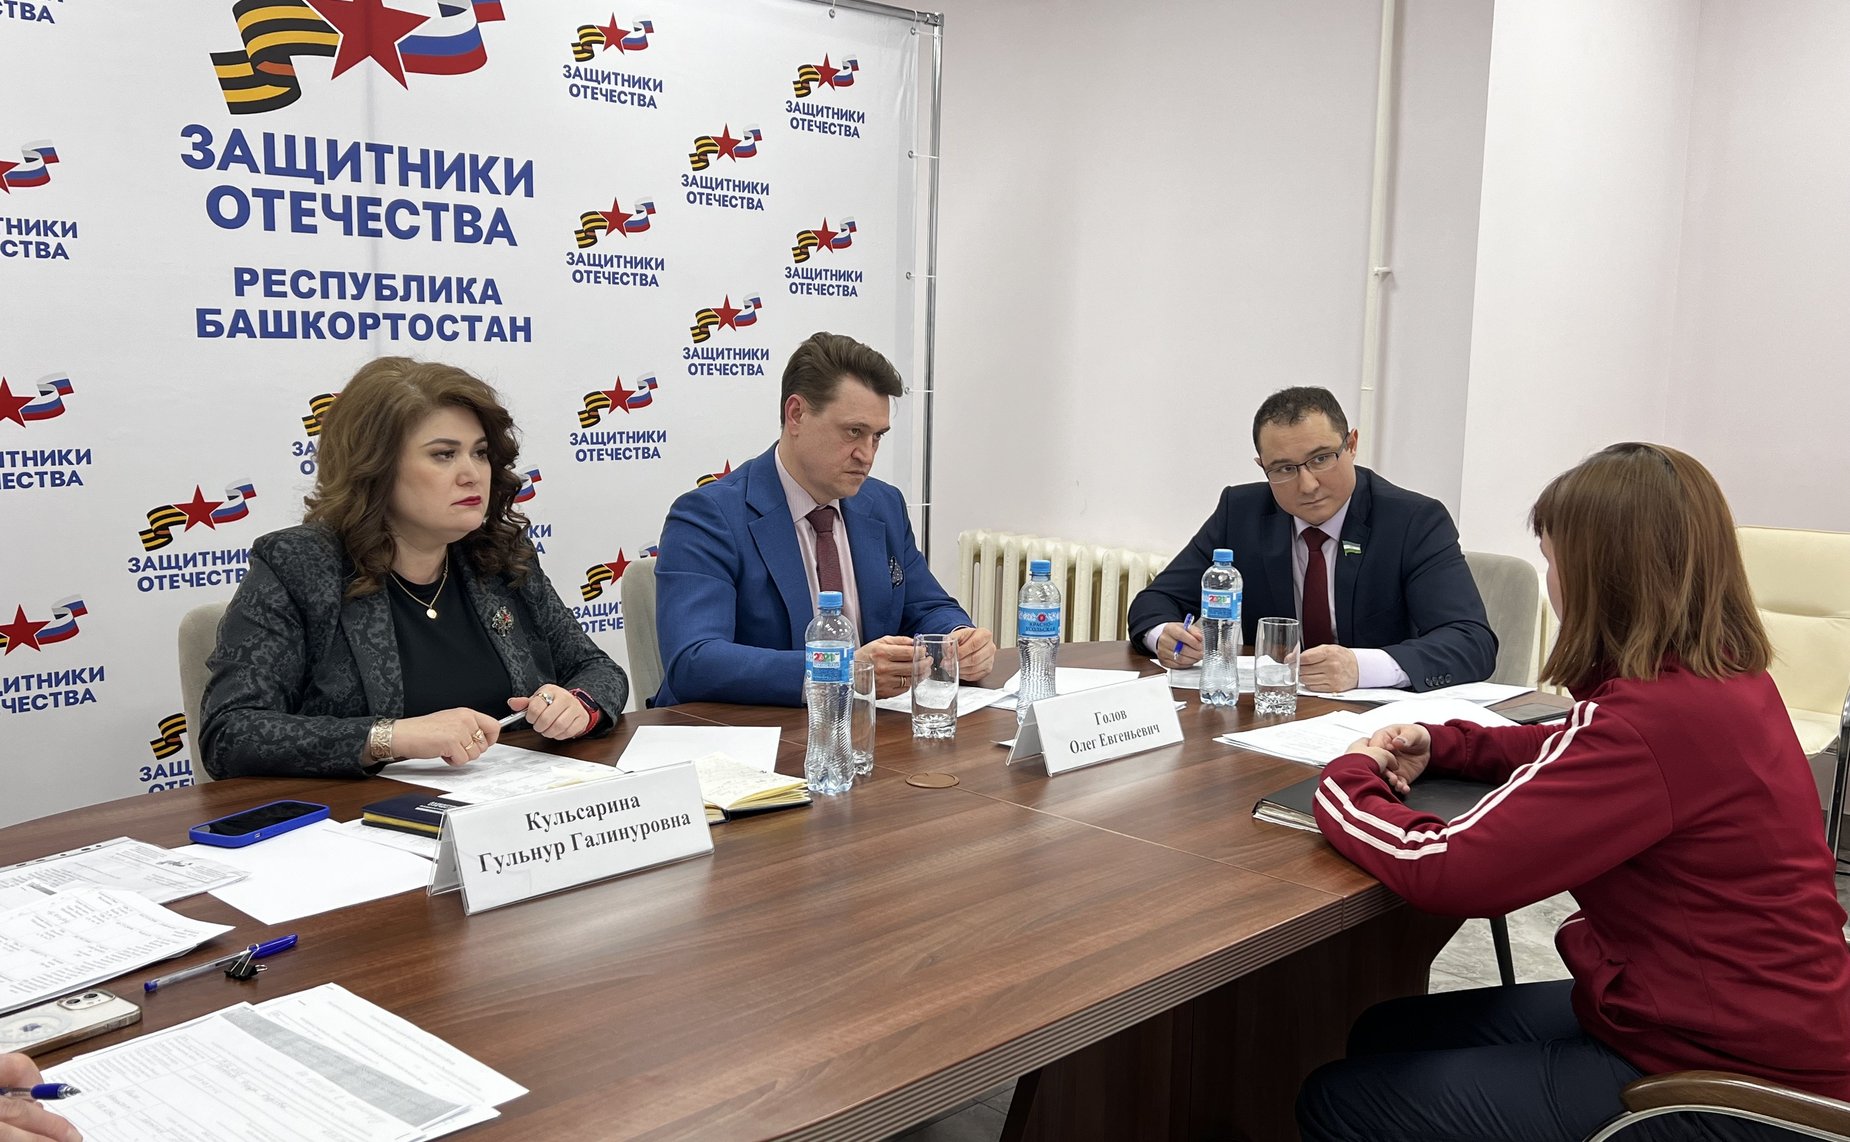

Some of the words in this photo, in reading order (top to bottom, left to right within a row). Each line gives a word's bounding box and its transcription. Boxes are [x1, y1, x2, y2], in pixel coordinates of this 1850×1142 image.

[562, 64, 663, 93] ЗАЩИТНИКИ
[568, 83, 657, 109] ОТЕЧЕСТВА
[785, 100, 865, 124] ЗАЩИТНИКИ
[789, 117, 860, 139] ОТЕЧЕСТВА
[180, 123, 535, 199] ЗАЩИТНИКИ
[681, 173, 770, 196] ЗАЩИТНИКИ
[686, 191, 764, 211] ОТЕЧЕСТВА
[205, 184, 518, 247] ОТЕЧЕСТВА
[0, 217, 78, 239] НИКИ
[565, 251, 665, 271] ЗАЩИТНИКИ
[233, 266, 503, 305] РЕСПУБЛИКА
[571, 269, 659, 287] ОТЕЧЕСТВА
[784, 266, 863, 283] ЗАЩИТНИКИ
[788, 282, 858, 297] ОТЕЧЕСТВА
[195, 307, 532, 343] БАШКОРТОСТАН
[682, 346, 769, 362] ЗАЩИТНИКИ
[687, 362, 764, 376] ОТЕЧЕСТВА
[569, 430, 667, 446] ЗАЩИТНИКИ
[575, 446, 661, 462] ОТЕЧЕСТВА
[0, 665, 105, 697] ИТНИКИ
[1094, 709, 1128, 726] Голов
[1069, 738, 1097, 754] Олег
[1098, 723, 1160, 748] Евгеньевич
[524, 795, 641, 833] Кульсарина
[477, 840, 566, 875] Гульнур
[570, 812, 692, 852] Галинуровна
